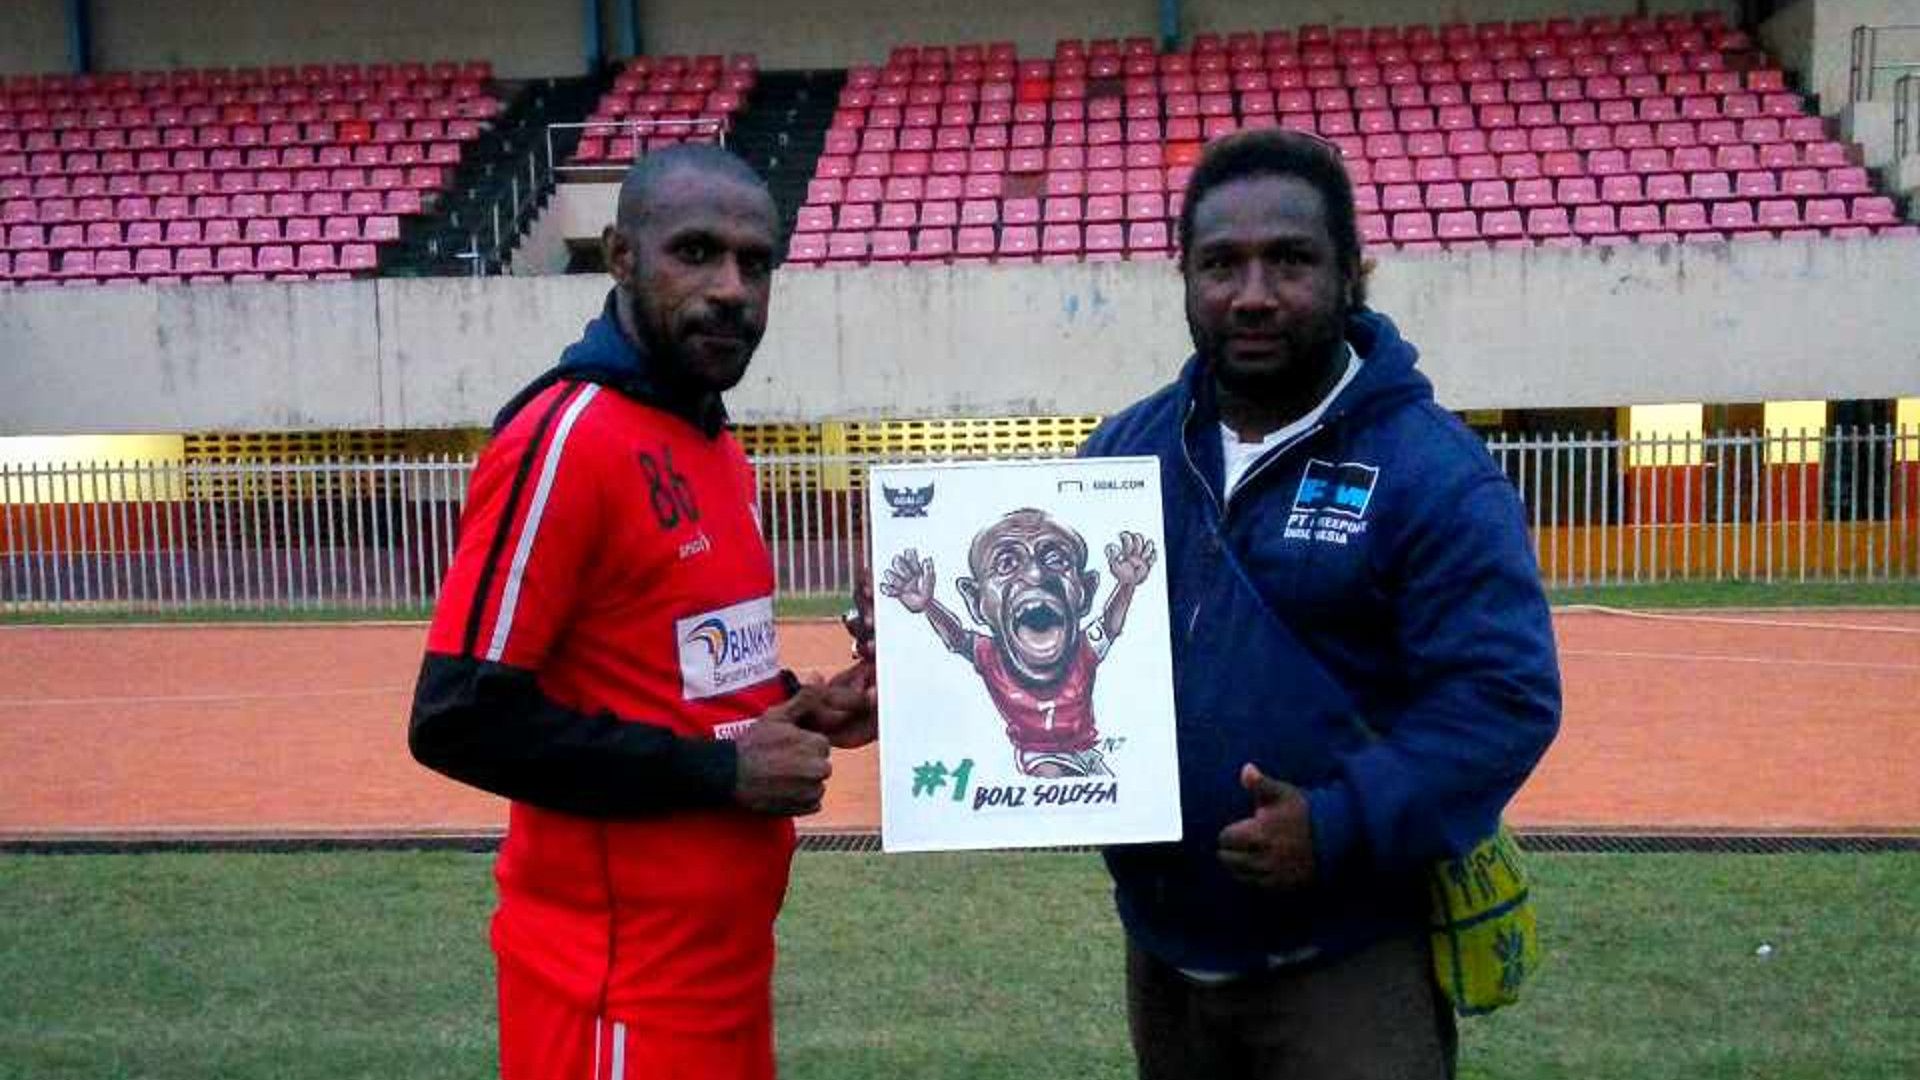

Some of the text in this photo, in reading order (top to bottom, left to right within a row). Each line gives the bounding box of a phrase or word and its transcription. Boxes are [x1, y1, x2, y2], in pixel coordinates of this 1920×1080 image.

[640, 446, 703, 529] 86
[1287, 514, 1309, 527] PT
[1037, 701, 1056, 731] 7
[911, 758, 975, 801] #1
[973, 781, 1119, 811] BOAZ SOLOSSA
